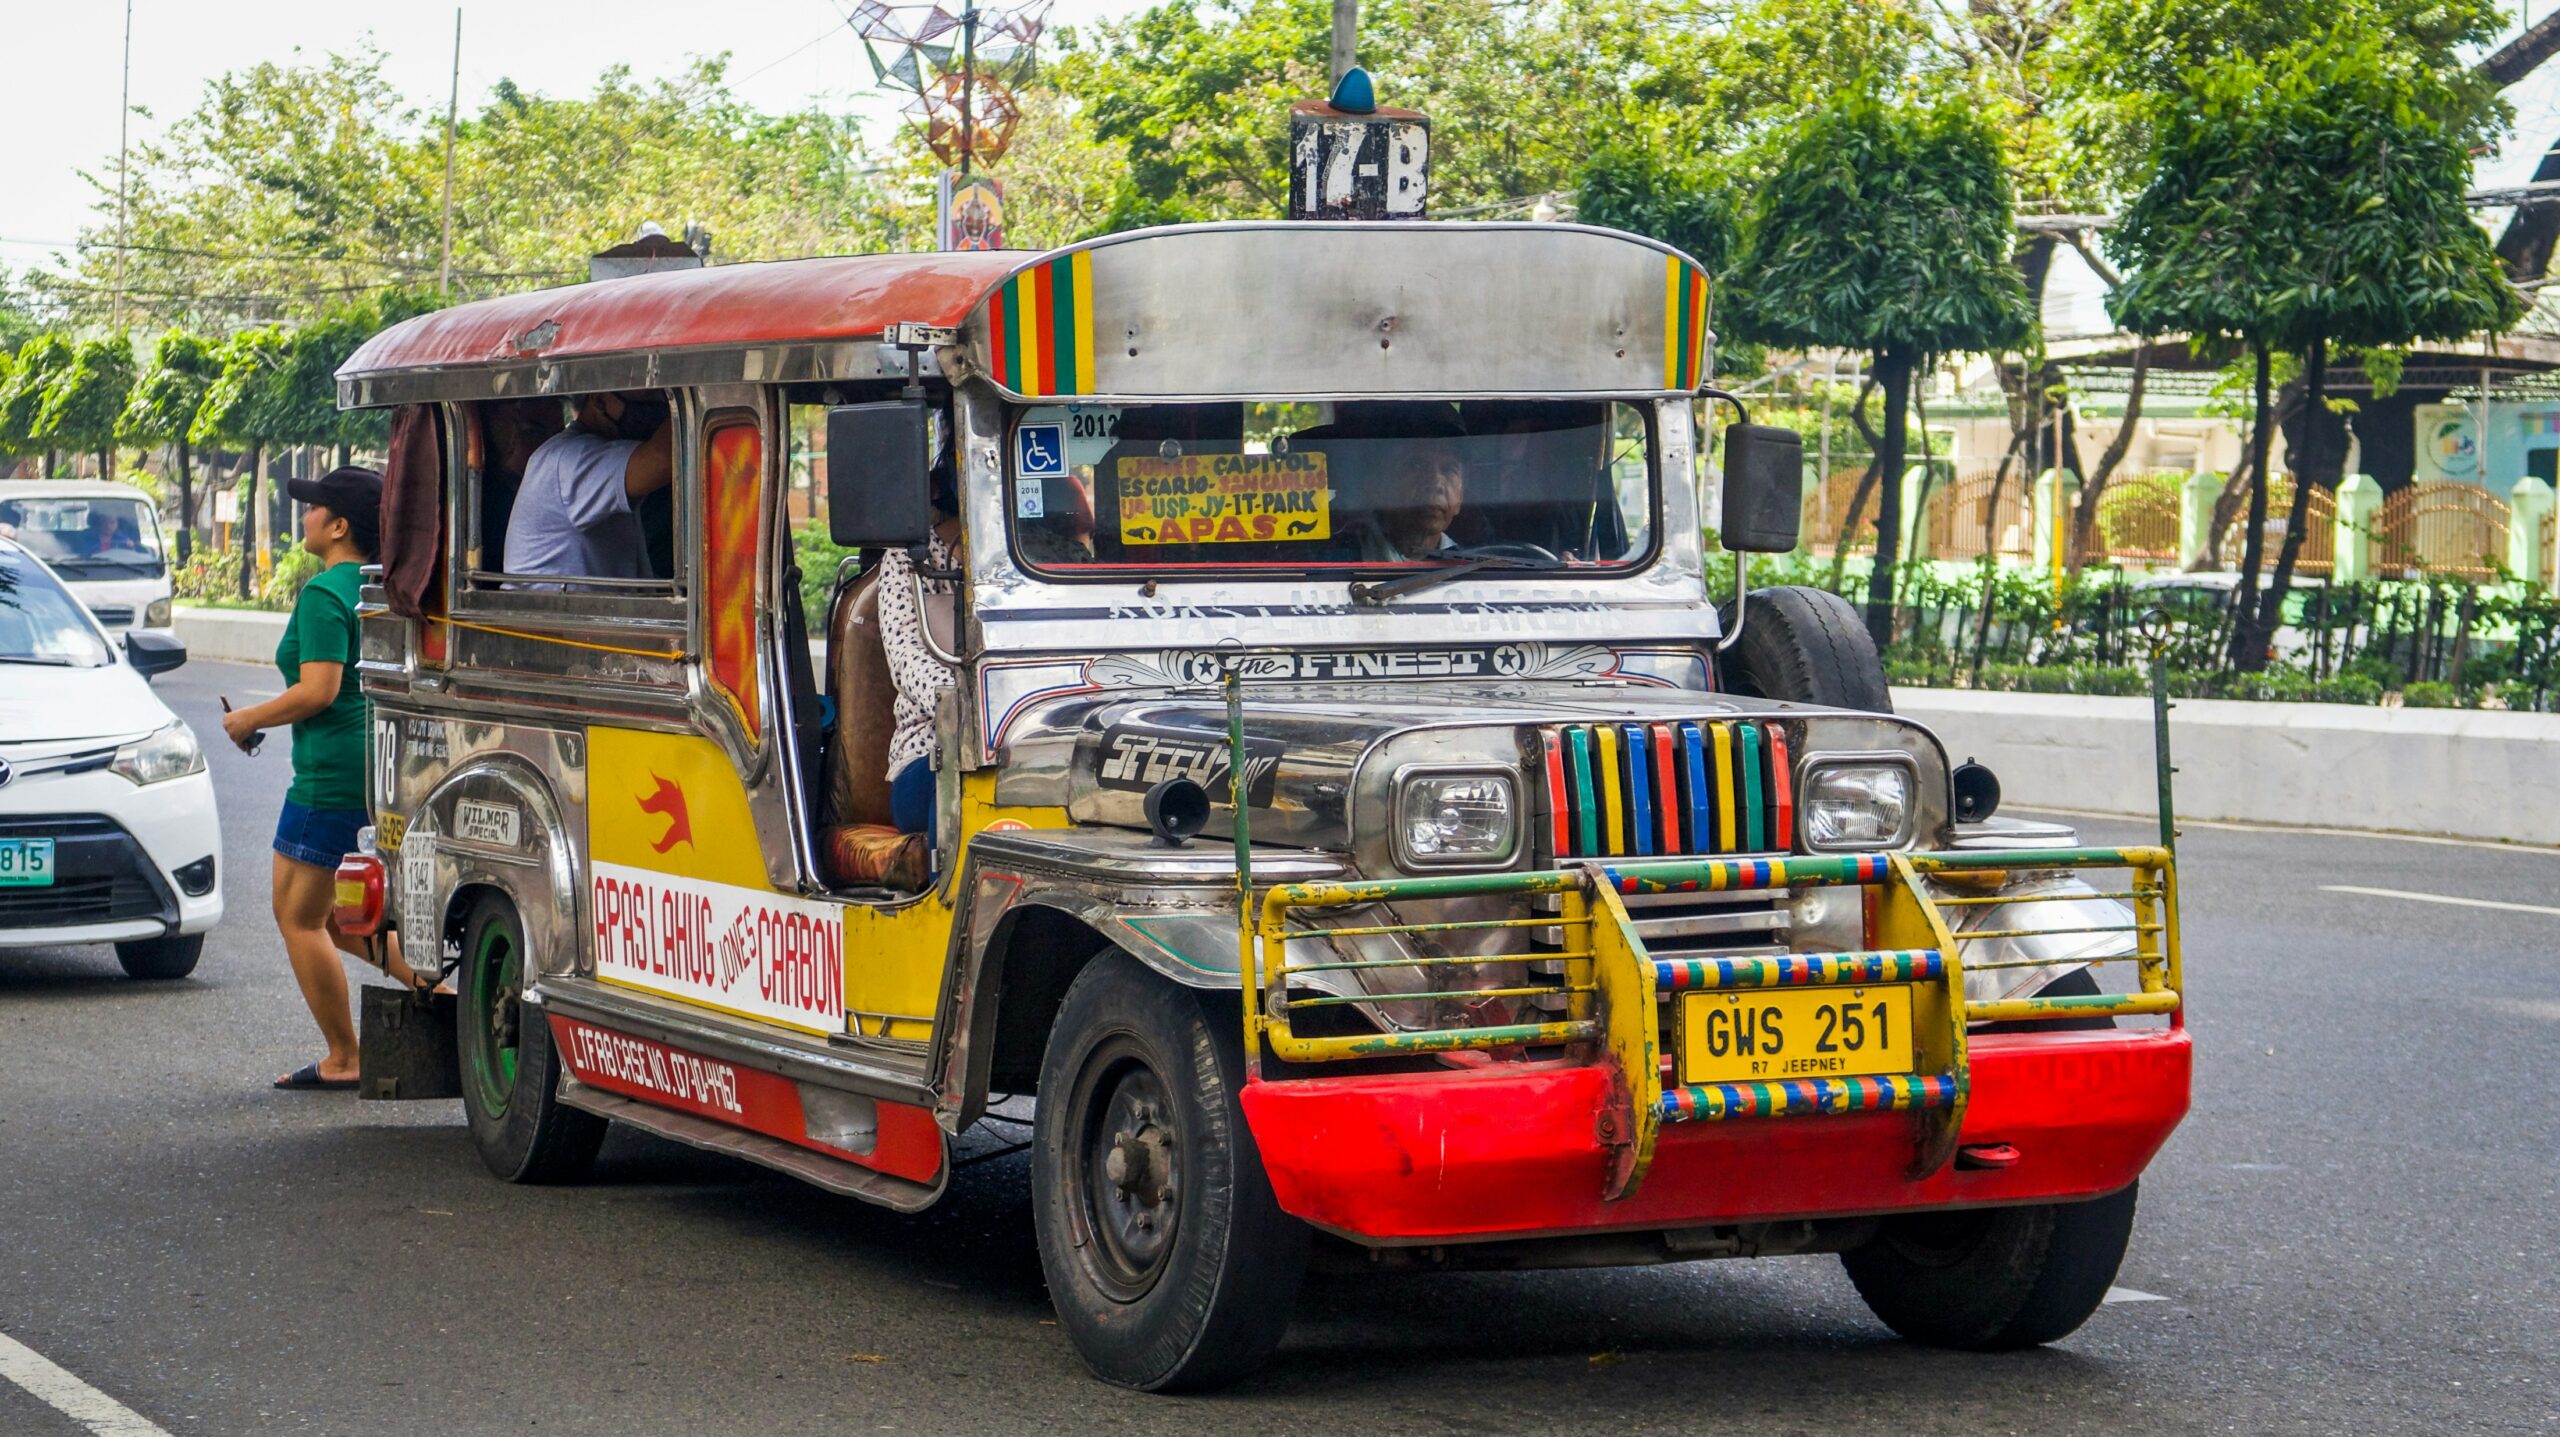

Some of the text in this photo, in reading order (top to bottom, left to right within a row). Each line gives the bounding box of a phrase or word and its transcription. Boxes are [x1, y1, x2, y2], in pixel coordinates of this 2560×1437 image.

[1296, 123, 1429, 213] 17-B
[1158, 514, 1278, 542] APAS
[1300, 651, 1486, 678] FINEST
[463, 806, 510, 840] WILMAR
[469, 825, 499, 840] SPECIAL
[0, 846, 44, 872] 815
[594, 876, 842, 1019] APAS LAHUG JONES CARBON
[1707, 1002, 1888, 1057] GWS 251
[612, 1036, 654, 1088] CASE
[1752, 1057, 1846, 1074] R7 JEEPNEY
